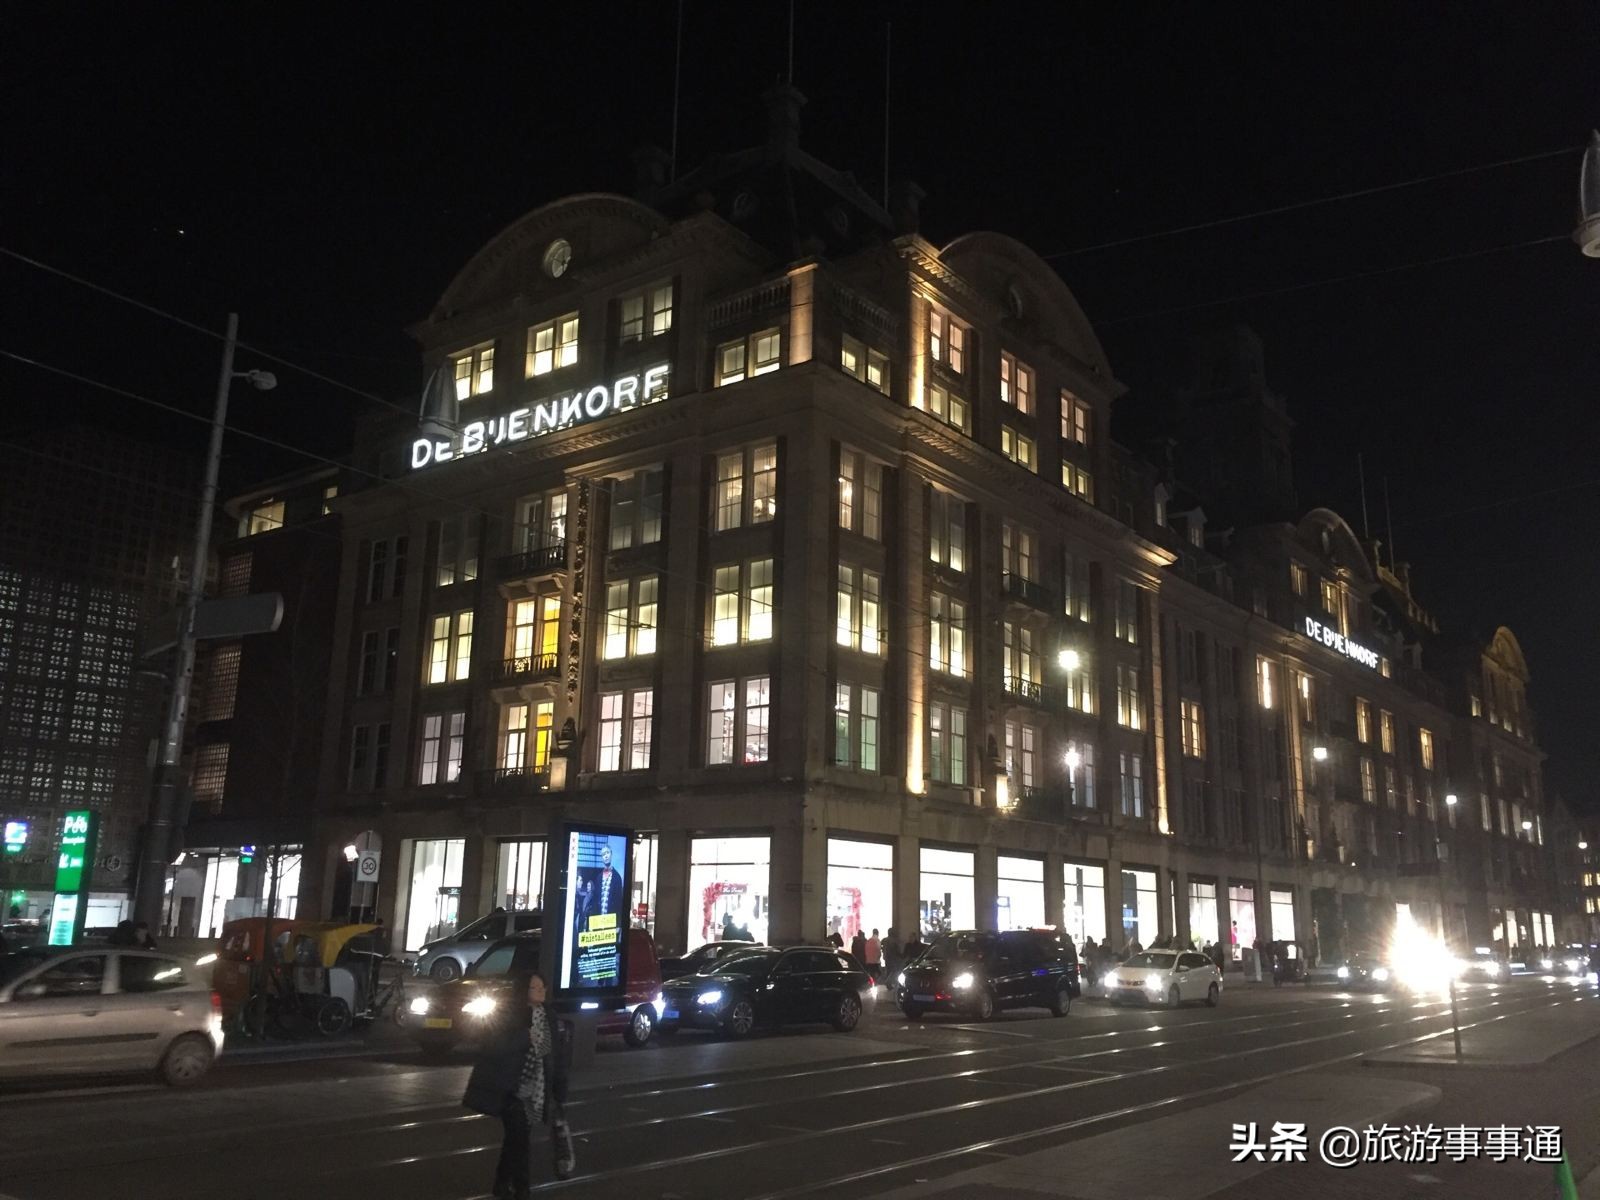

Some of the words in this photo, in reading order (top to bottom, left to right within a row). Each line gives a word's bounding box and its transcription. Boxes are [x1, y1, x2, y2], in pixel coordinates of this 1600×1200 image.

[411, 437, 454, 469] DE
[462, 364, 669, 454] BIJENKORF
[1305, 616, 1323, 642] DE
